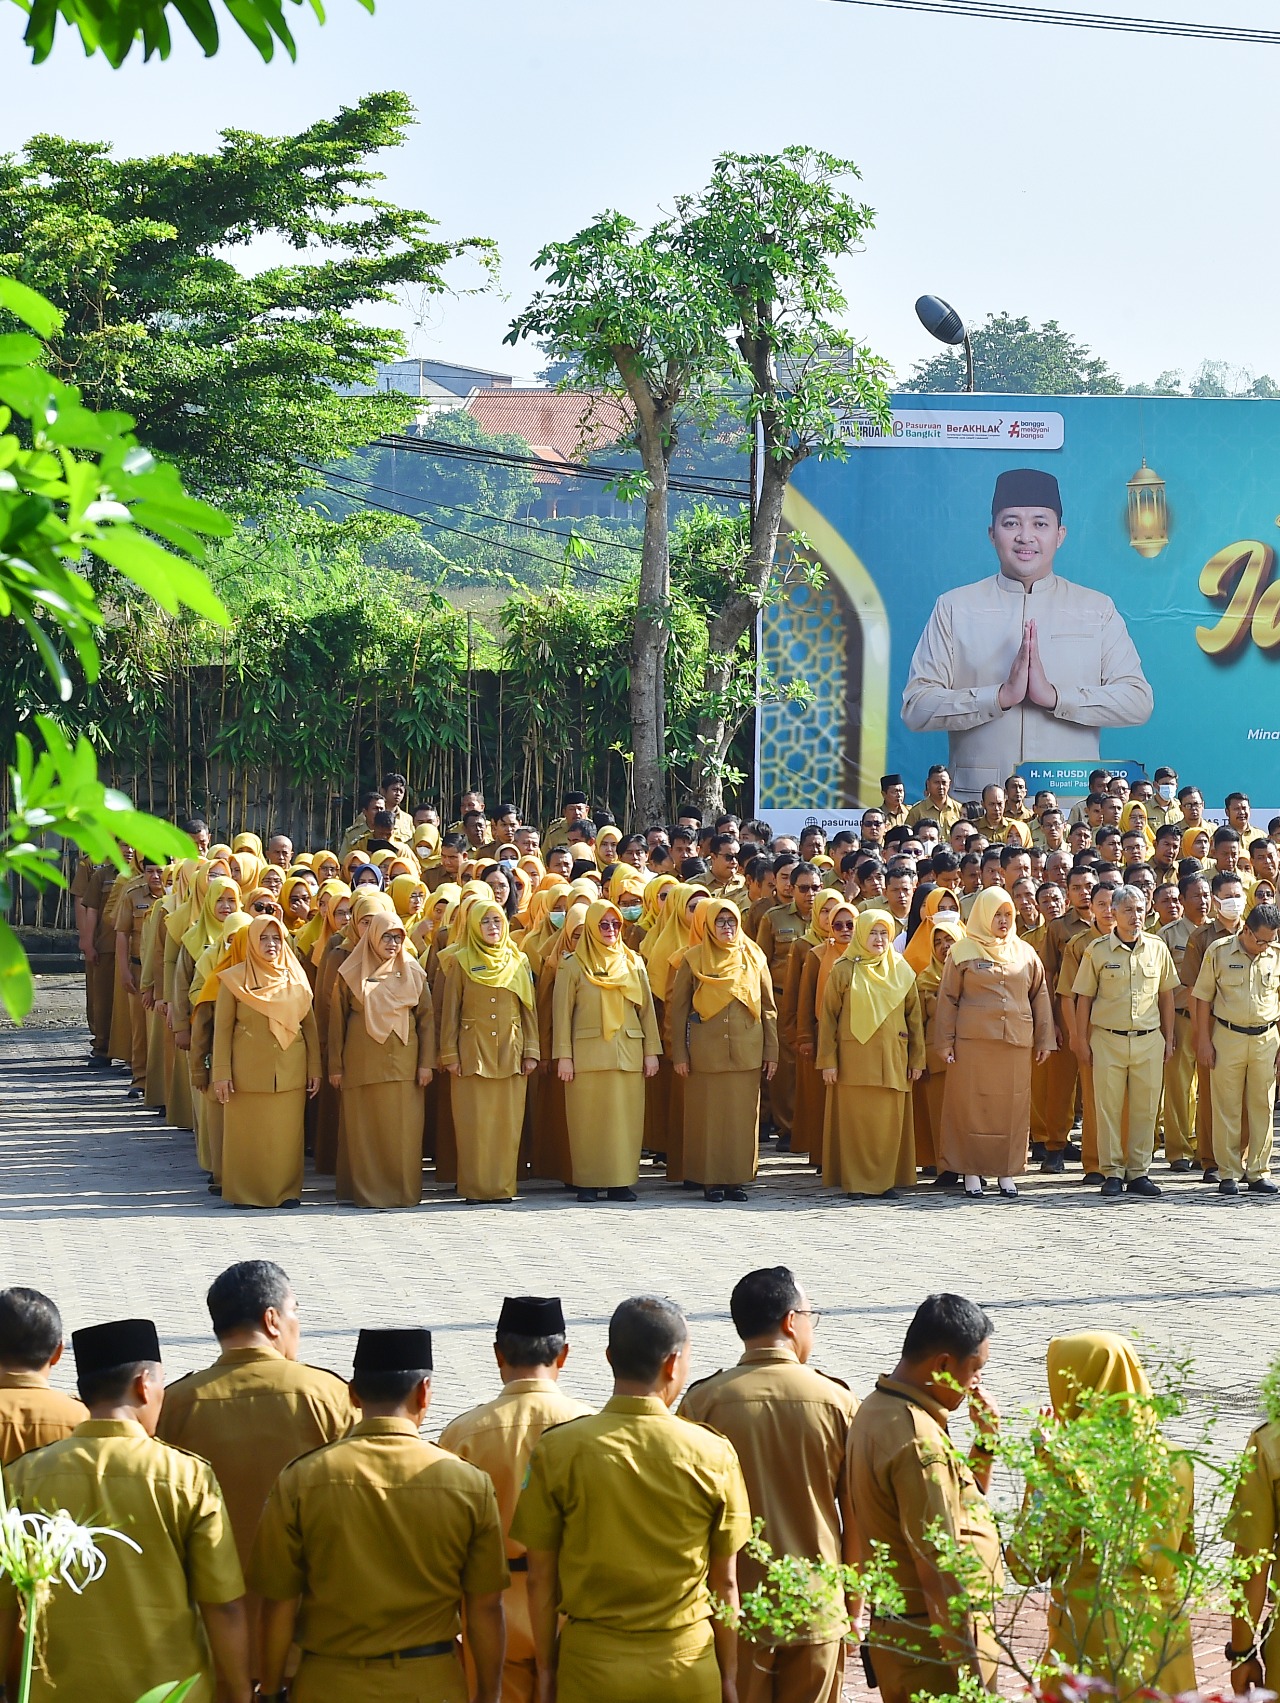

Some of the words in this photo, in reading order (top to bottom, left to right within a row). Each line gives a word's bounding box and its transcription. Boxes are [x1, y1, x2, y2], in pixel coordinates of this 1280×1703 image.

[905, 421, 942, 429] Pasuruan
[1020, 420, 1045, 428] bangga
[946, 424, 1000, 433] BerAKHLAK
[905, 429, 941, 439] Bangkit
[1030, 770, 1040, 778] H.
[1043, 770, 1054, 778] M.
[1056, 770, 1087, 778] RUSDI
[1049, 781, 1073, 789] Bupati
